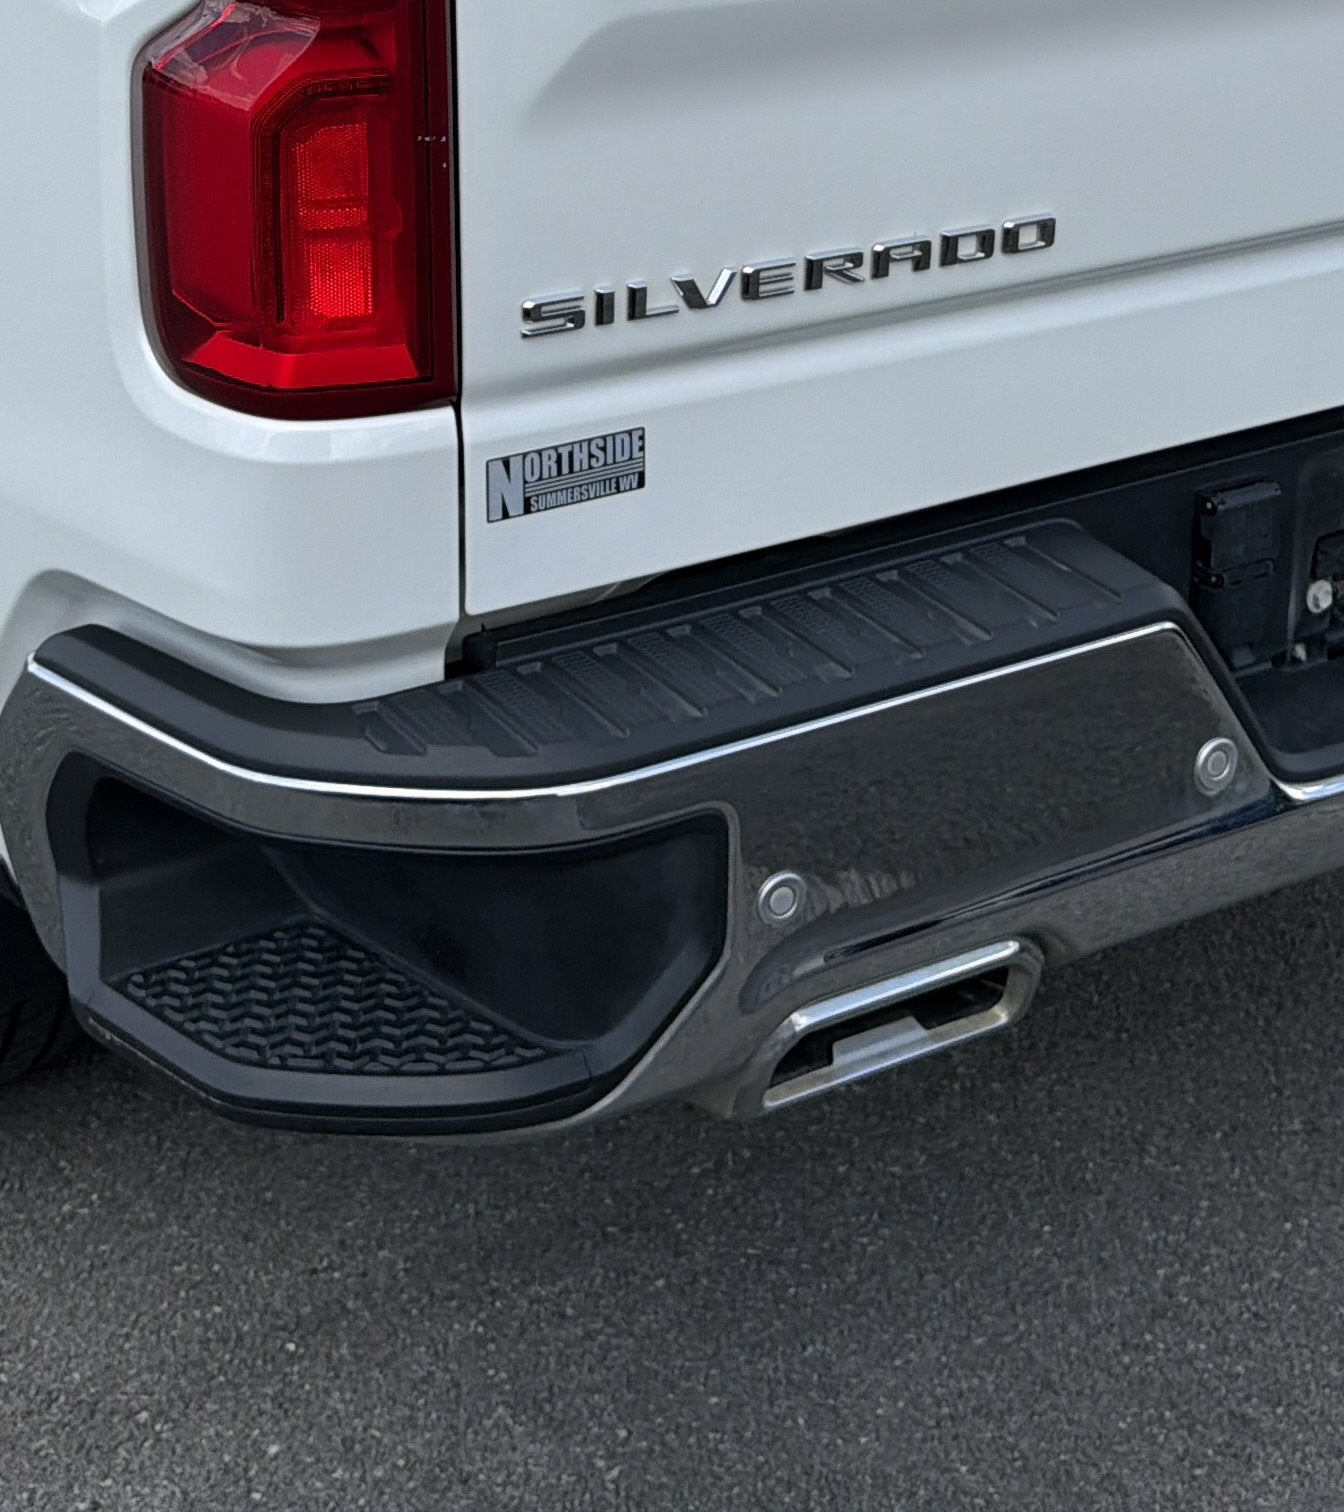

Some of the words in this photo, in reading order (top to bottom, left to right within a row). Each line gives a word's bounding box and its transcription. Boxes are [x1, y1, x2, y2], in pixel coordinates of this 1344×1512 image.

[520, 212, 1056, 339] SILVERADO
[487, 428, 644, 522] NORTHSIDE
[529, 478, 617, 512] SUMMERSVILLE
[618, 472, 639, 491] WV
